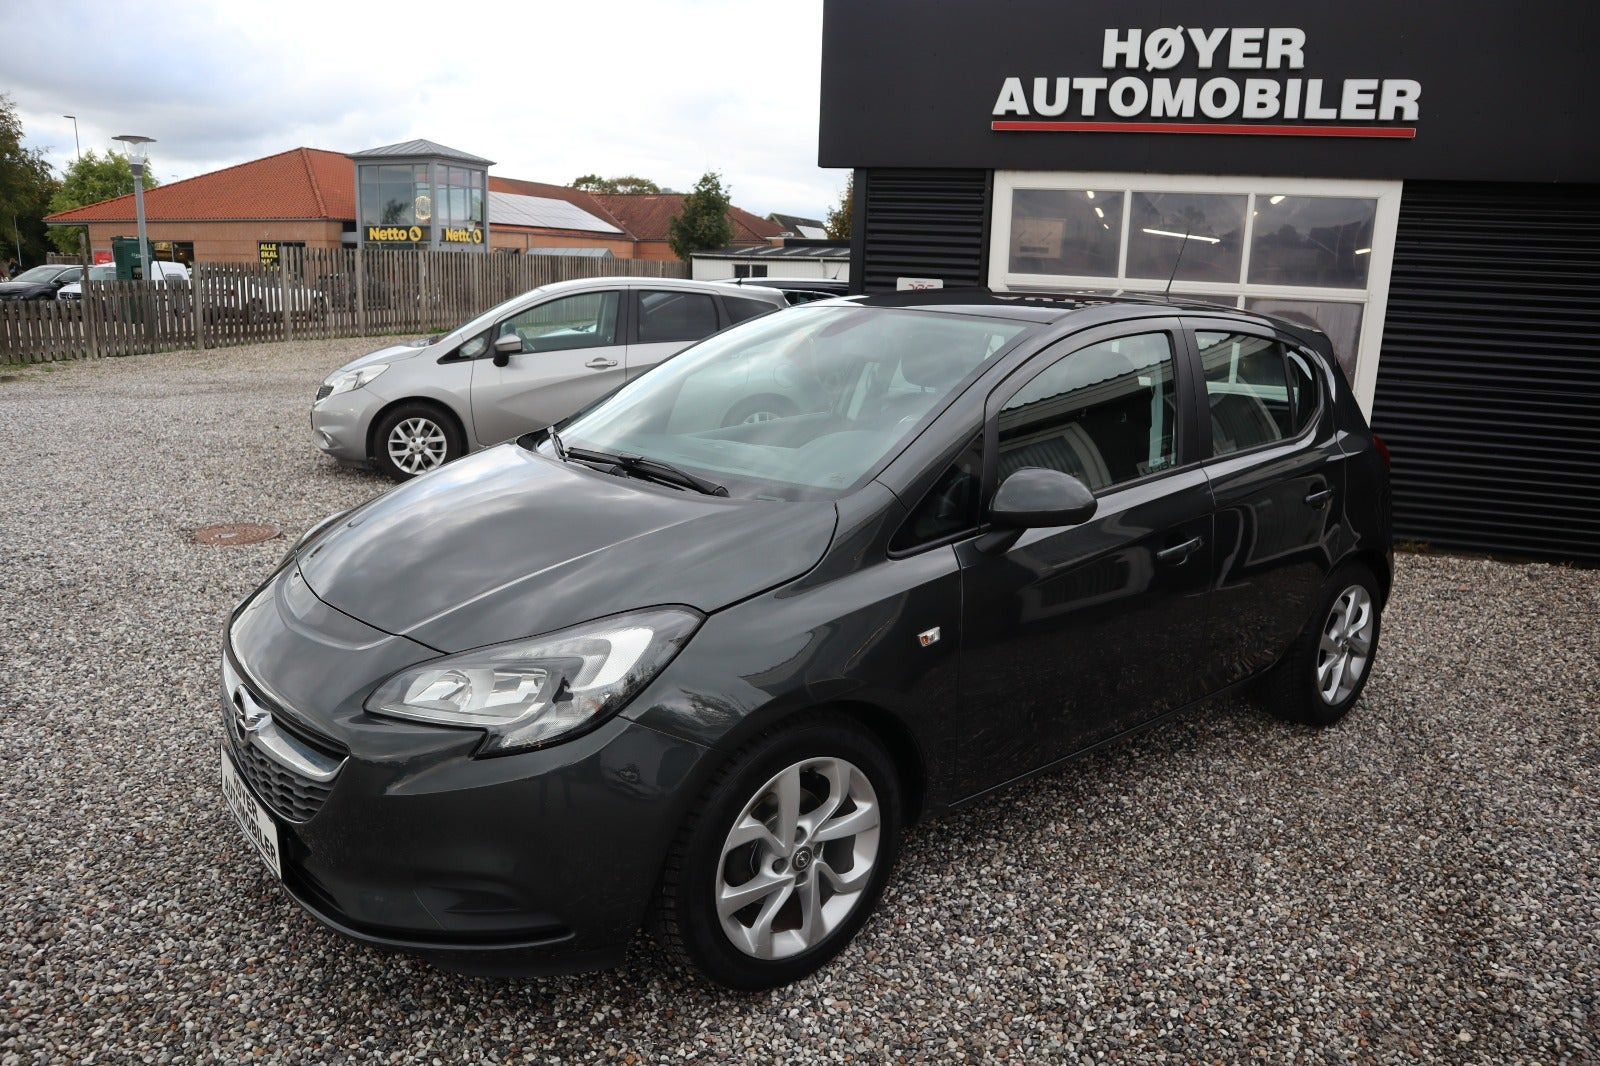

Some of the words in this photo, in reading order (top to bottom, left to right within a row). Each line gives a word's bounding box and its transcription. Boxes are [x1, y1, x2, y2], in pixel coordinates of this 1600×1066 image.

[1102, 25, 1306, 72] HØYER
[992, 76, 1421, 121] AUTOMOBILER
[369, 227, 408, 240] Netto
[224, 775, 277, 866] AUTOMOBILER
